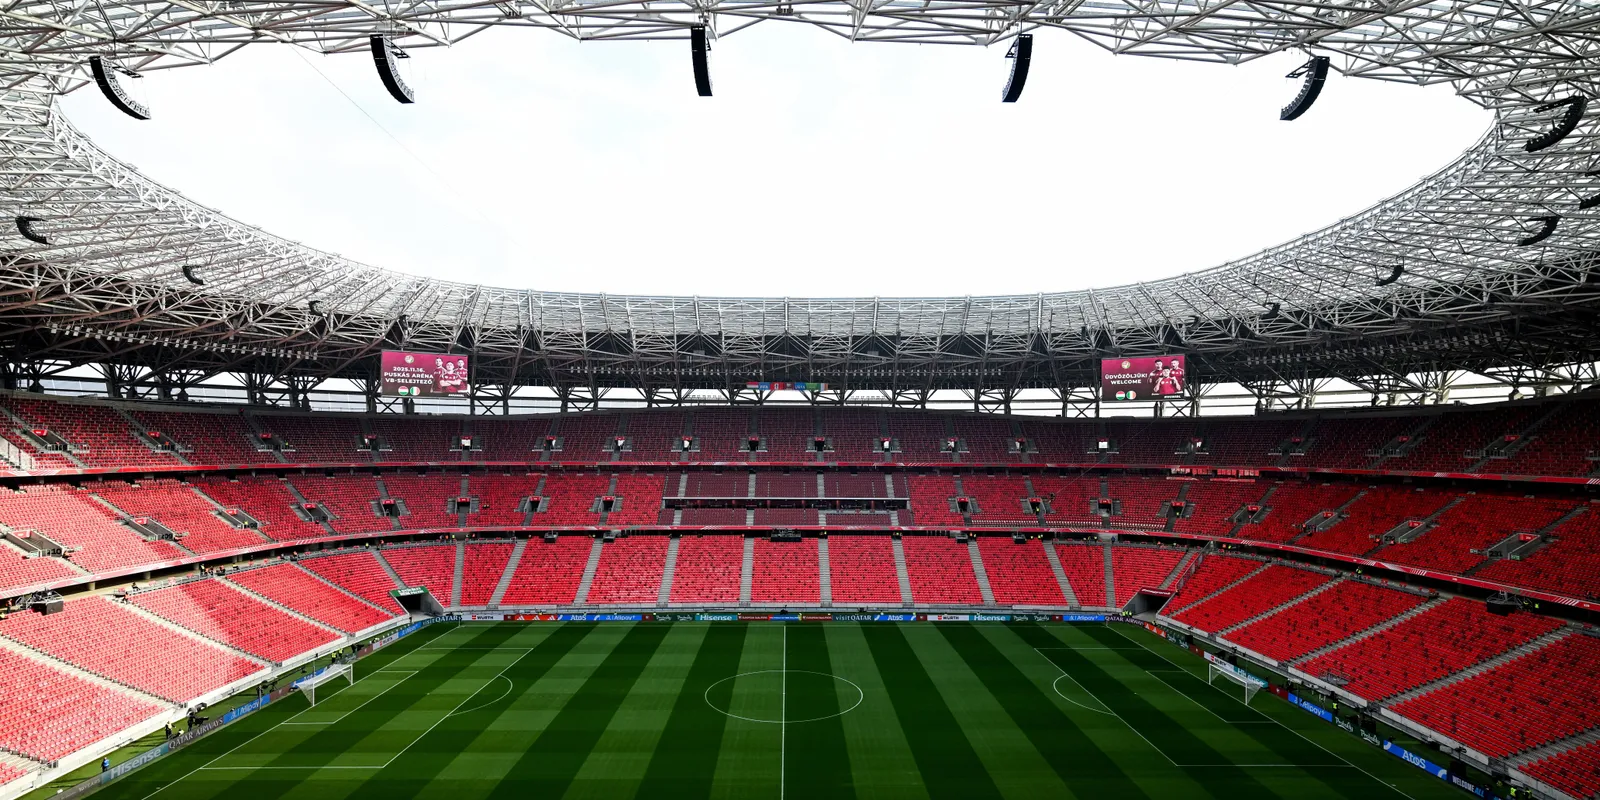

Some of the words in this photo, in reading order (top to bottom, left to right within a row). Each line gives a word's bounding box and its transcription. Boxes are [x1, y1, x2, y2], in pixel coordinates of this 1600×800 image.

[435, 615, 458, 623] QATAR
[1237, 667, 1265, 687] Hiense
[169, 731, 194, 749] QATAR
[195, 717, 223, 735] AIRWAYS
[110, 748, 161, 780] Hisense
[1451, 775, 1475, 792] WELCOME
[1474, 787, 1485, 798] ALL
